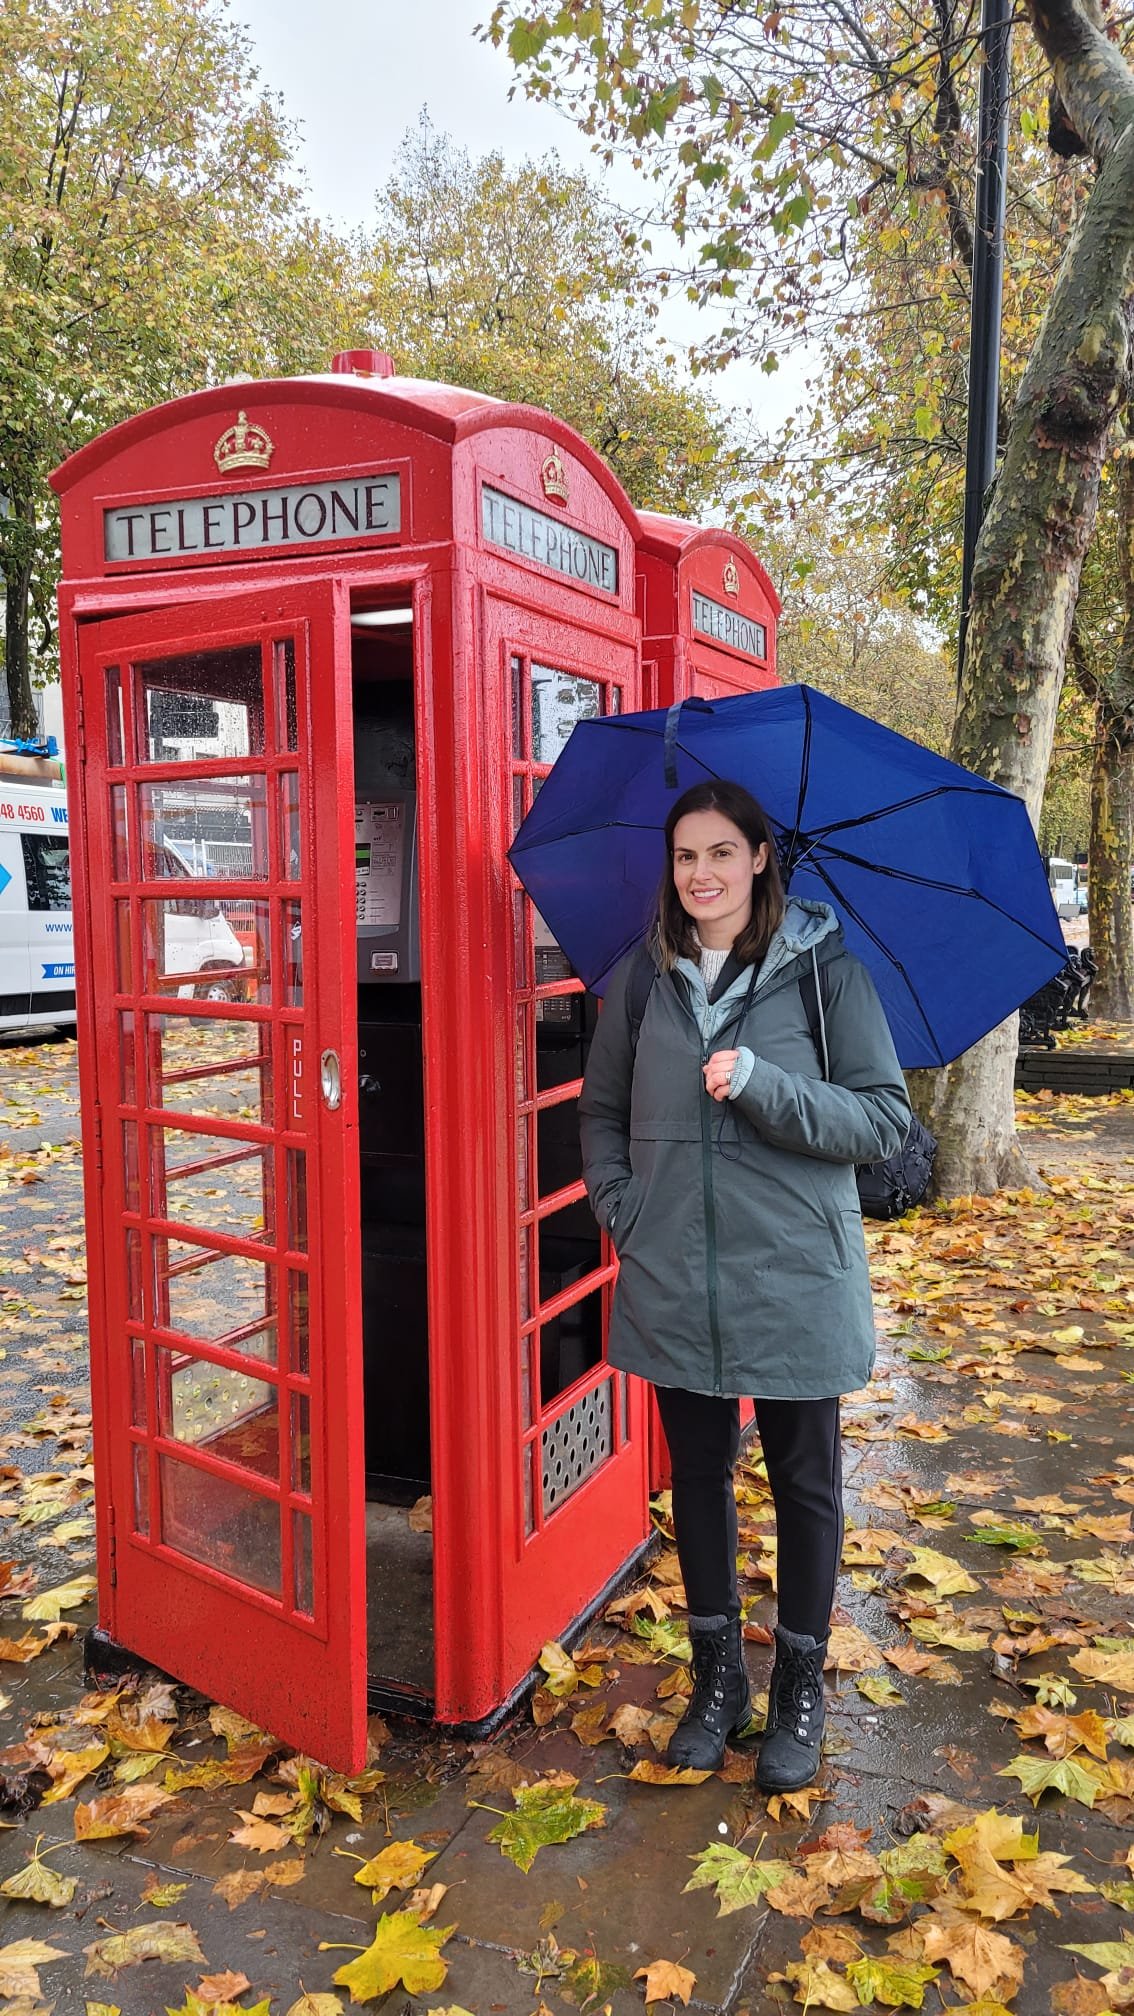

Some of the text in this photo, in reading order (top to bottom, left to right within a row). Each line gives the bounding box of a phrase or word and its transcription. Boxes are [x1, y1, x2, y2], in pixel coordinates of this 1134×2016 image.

[116, 484, 389, 555] TELEPHONE
[483, 495, 611, 590] TELEPHONE
[692, 597, 762, 656] TELEPHONE
[17, 805, 45, 821] 4560
[53, 966, 64, 976] ON
[293, 1039, 303, 1118] PULL
